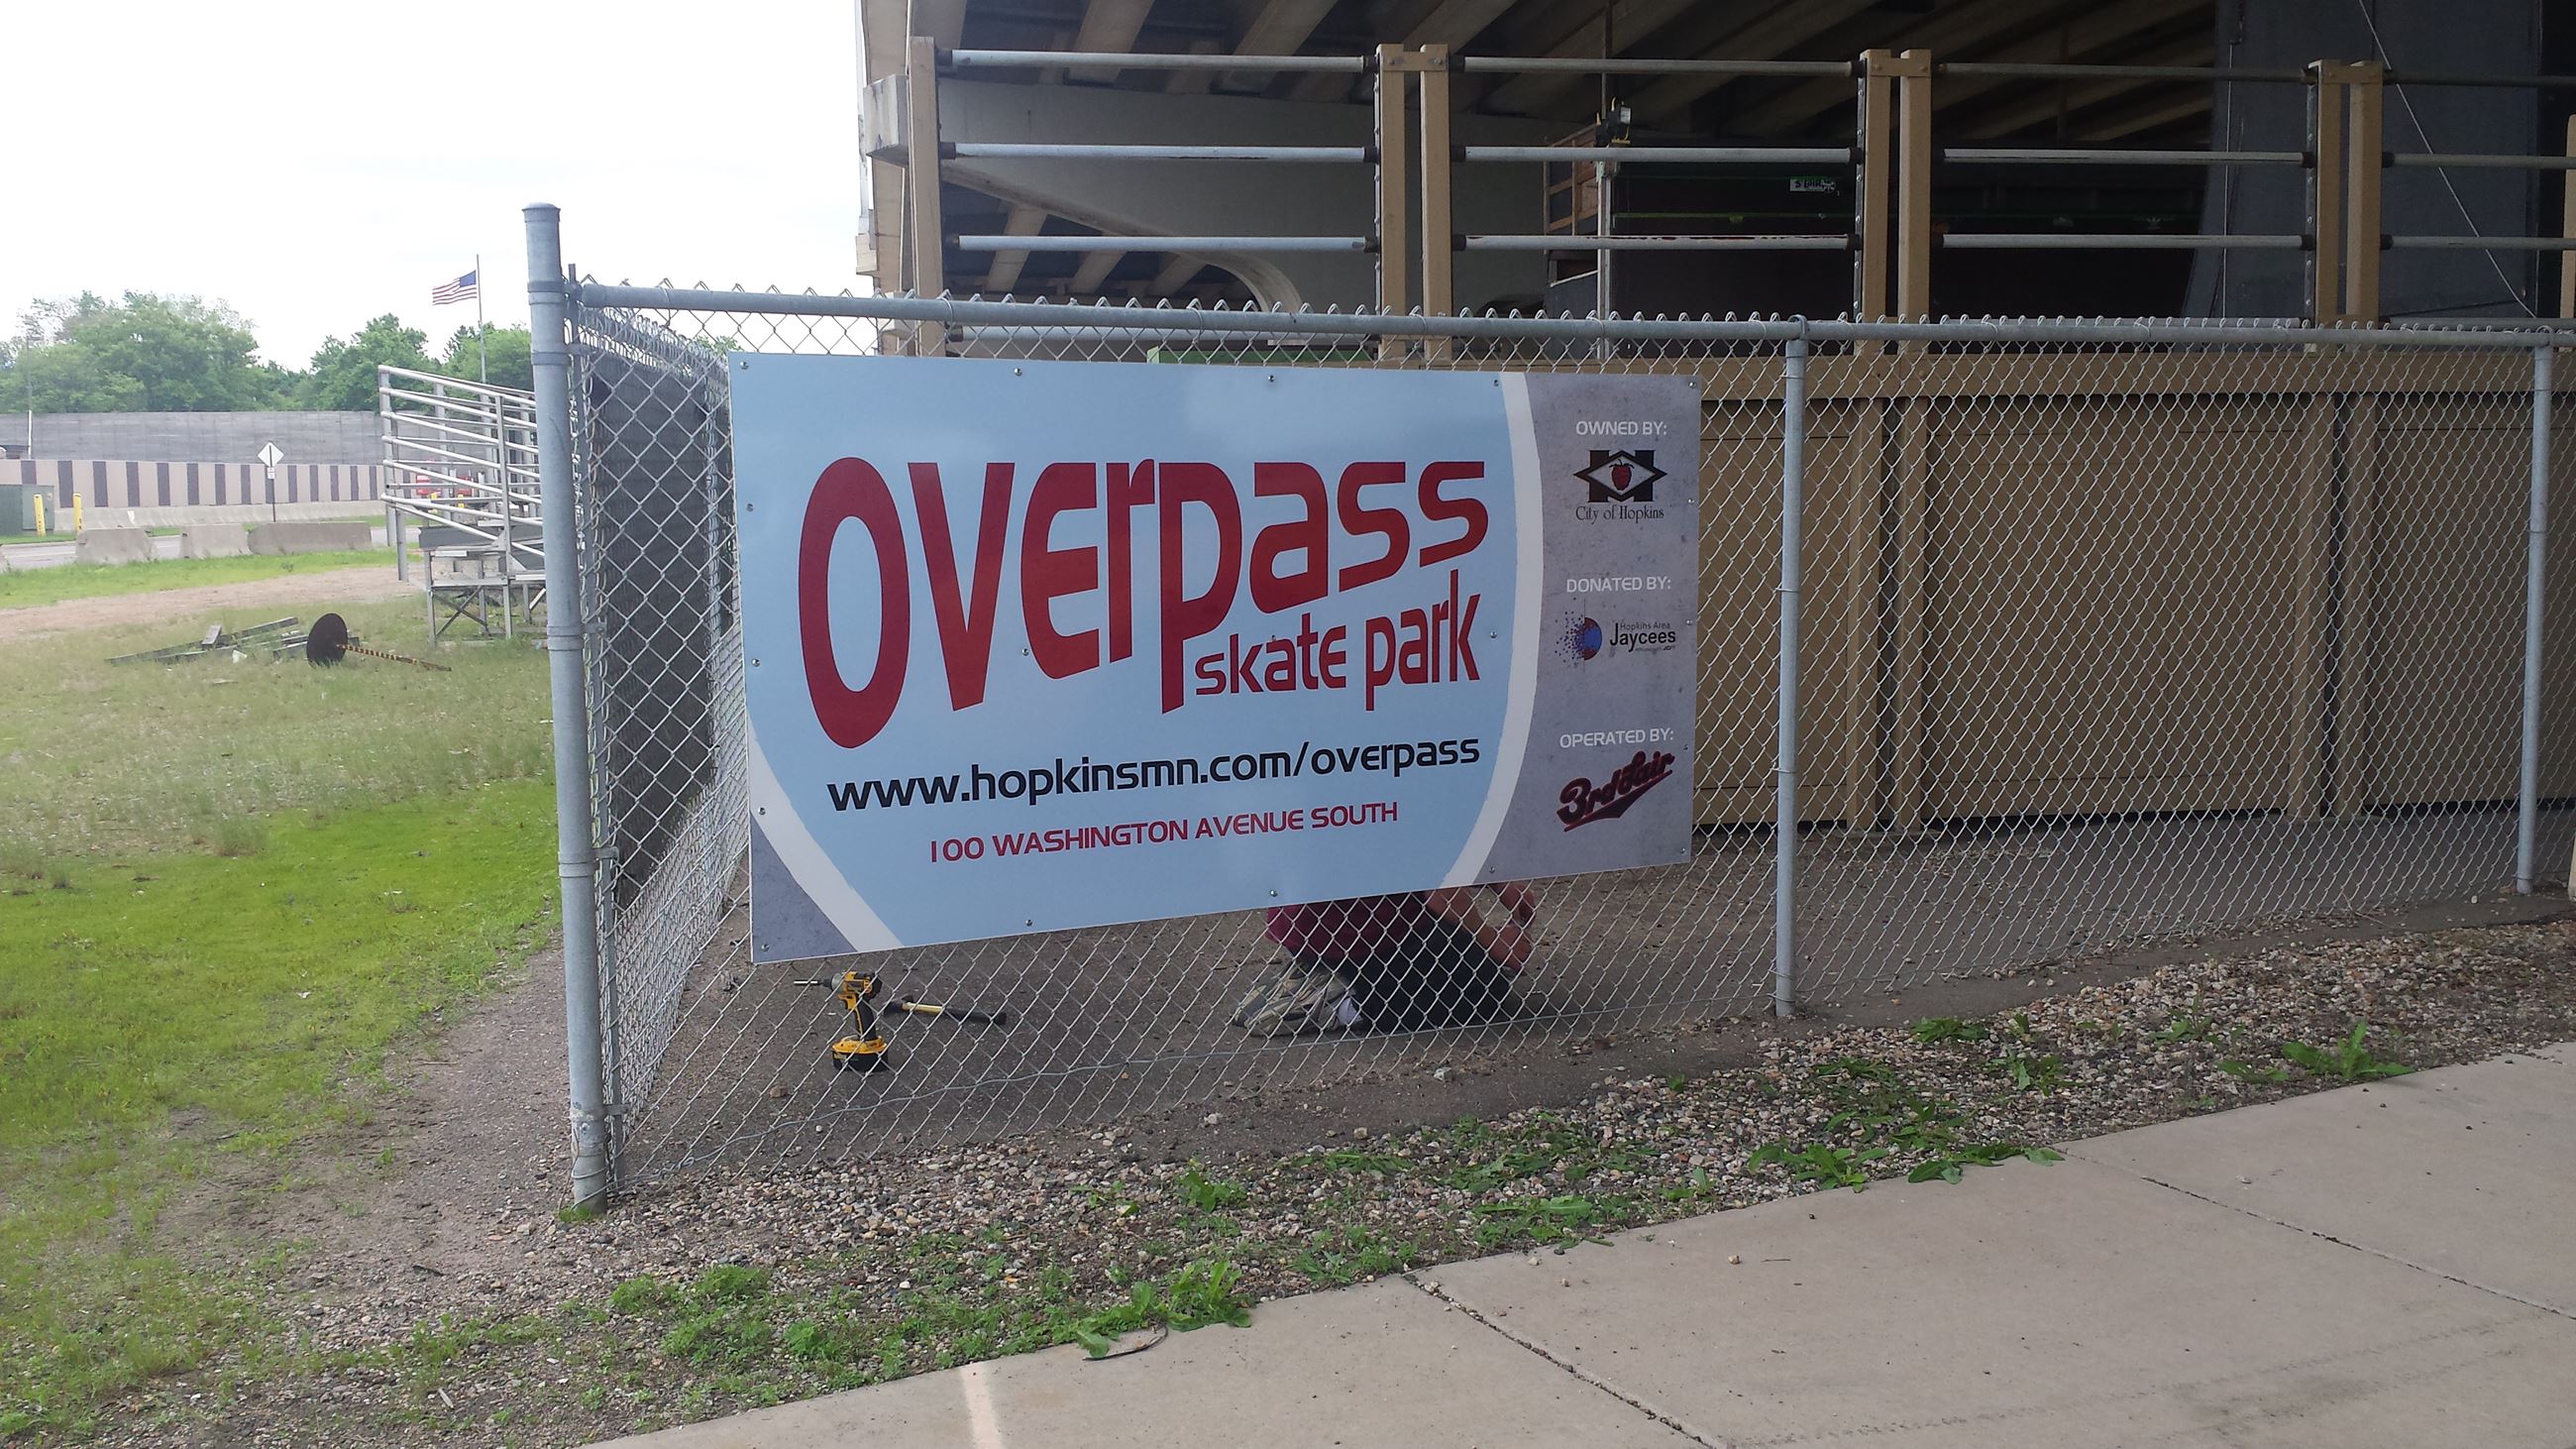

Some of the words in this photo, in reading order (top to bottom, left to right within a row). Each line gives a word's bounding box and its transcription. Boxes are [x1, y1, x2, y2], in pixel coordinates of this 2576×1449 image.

[1575, 420, 1638, 435] OWNED
[1642, 421, 1666, 435] BY:
[1575, 505, 1598, 524] City
[1603, 504, 1617, 519] of
[1619, 504, 1664, 523] Hopkins
[1566, 577, 1642, 593] DONATED
[1647, 576, 1671, 590] BY:
[1610, 622, 1676, 652] Jaycees
[1620, 622, 1651, 631] Hopkins
[1195, 613, 1346, 695] skate
[1365, 569, 1481, 712] park
[1559, 729, 1646, 748] OPERATED
[1650, 727, 1674, 742] BY:
[826, 738, 1480, 812] www.hopkinsmn.com/overpass
[931, 836, 985, 863] 100
[992, 820, 1188, 856] WASHINGTON
[1195, 810, 1304, 838] AVENUE
[1312, 802, 1398, 829] SOUTH
